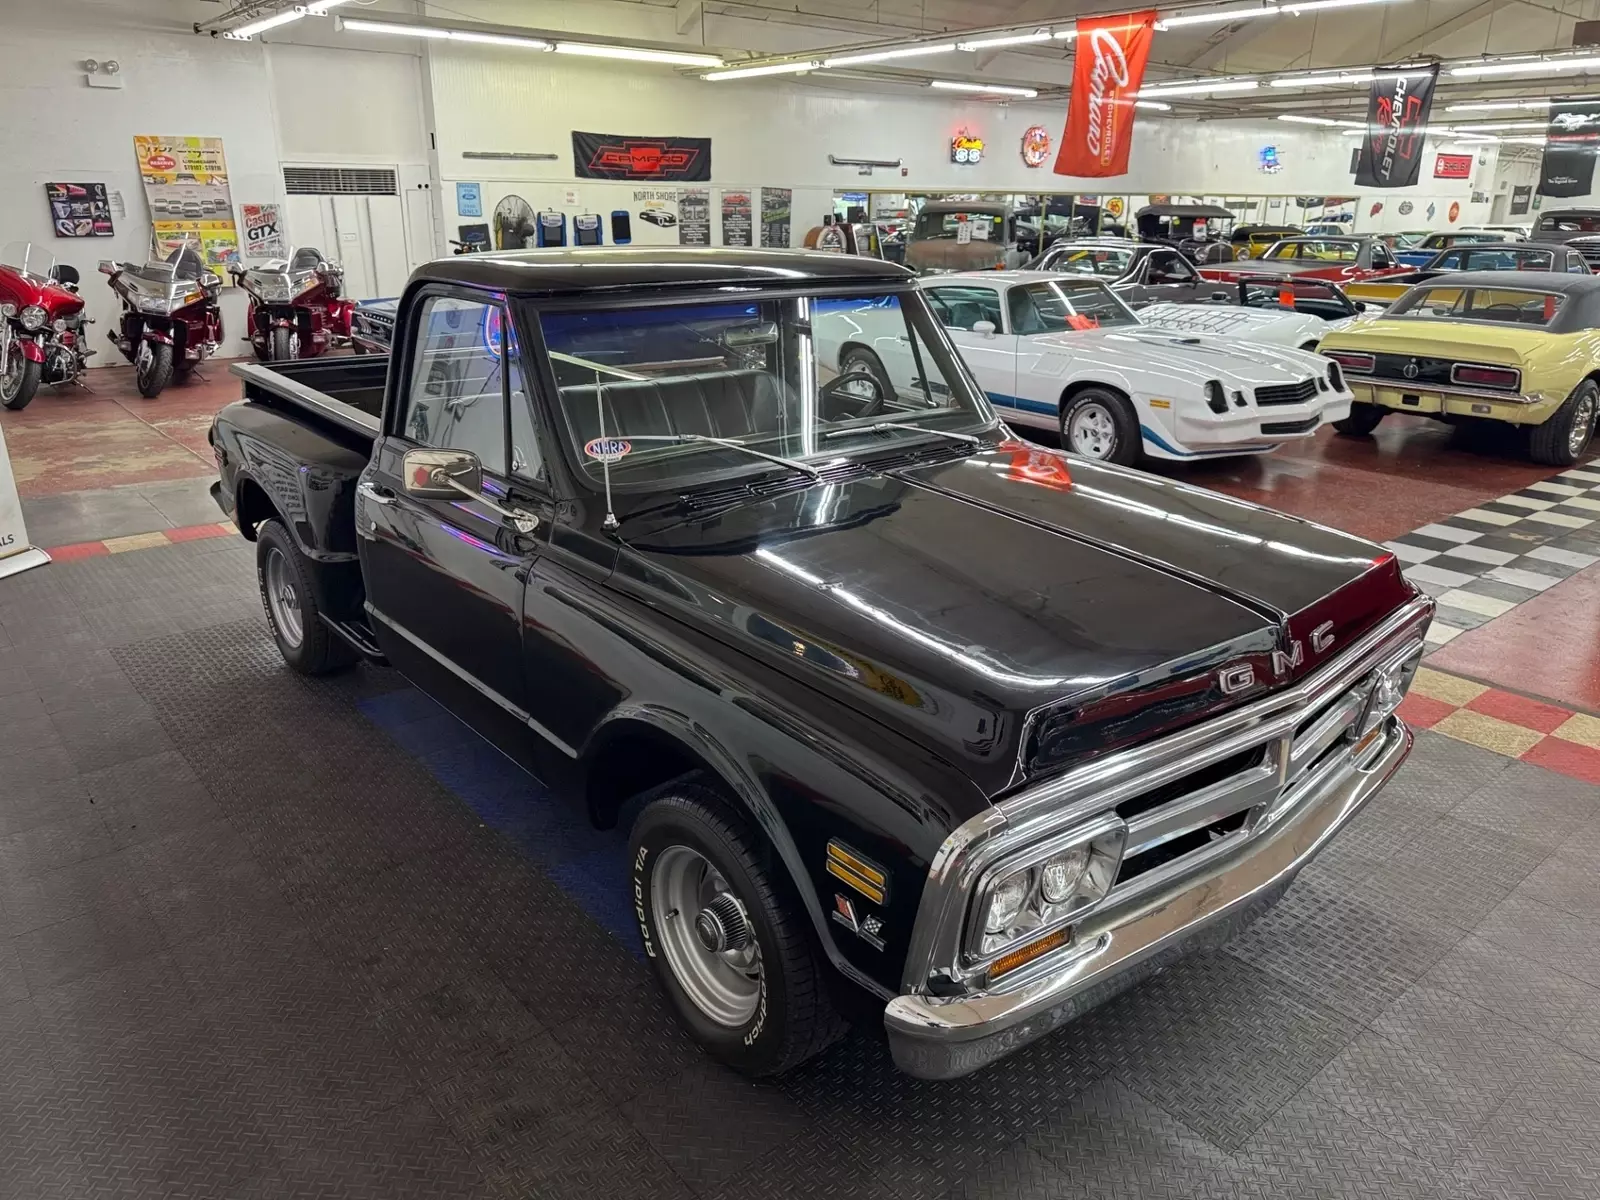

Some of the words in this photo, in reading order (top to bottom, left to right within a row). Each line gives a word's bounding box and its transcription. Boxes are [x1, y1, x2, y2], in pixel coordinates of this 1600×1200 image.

[1088, 28, 1129, 156] Camaro
[1381, 76, 1408, 181] CHEVROLET
[606, 154, 683, 164] CAMARO
[633, 190, 655, 202] NORTH
[655, 190, 677, 203] SHORE
[247, 221, 279, 241] GTX
[593, 441, 624, 454] NHRA
[1219, 620, 1335, 694] GMC
[635, 846, 649, 872] T/A
[634, 876, 657, 958] Radial
